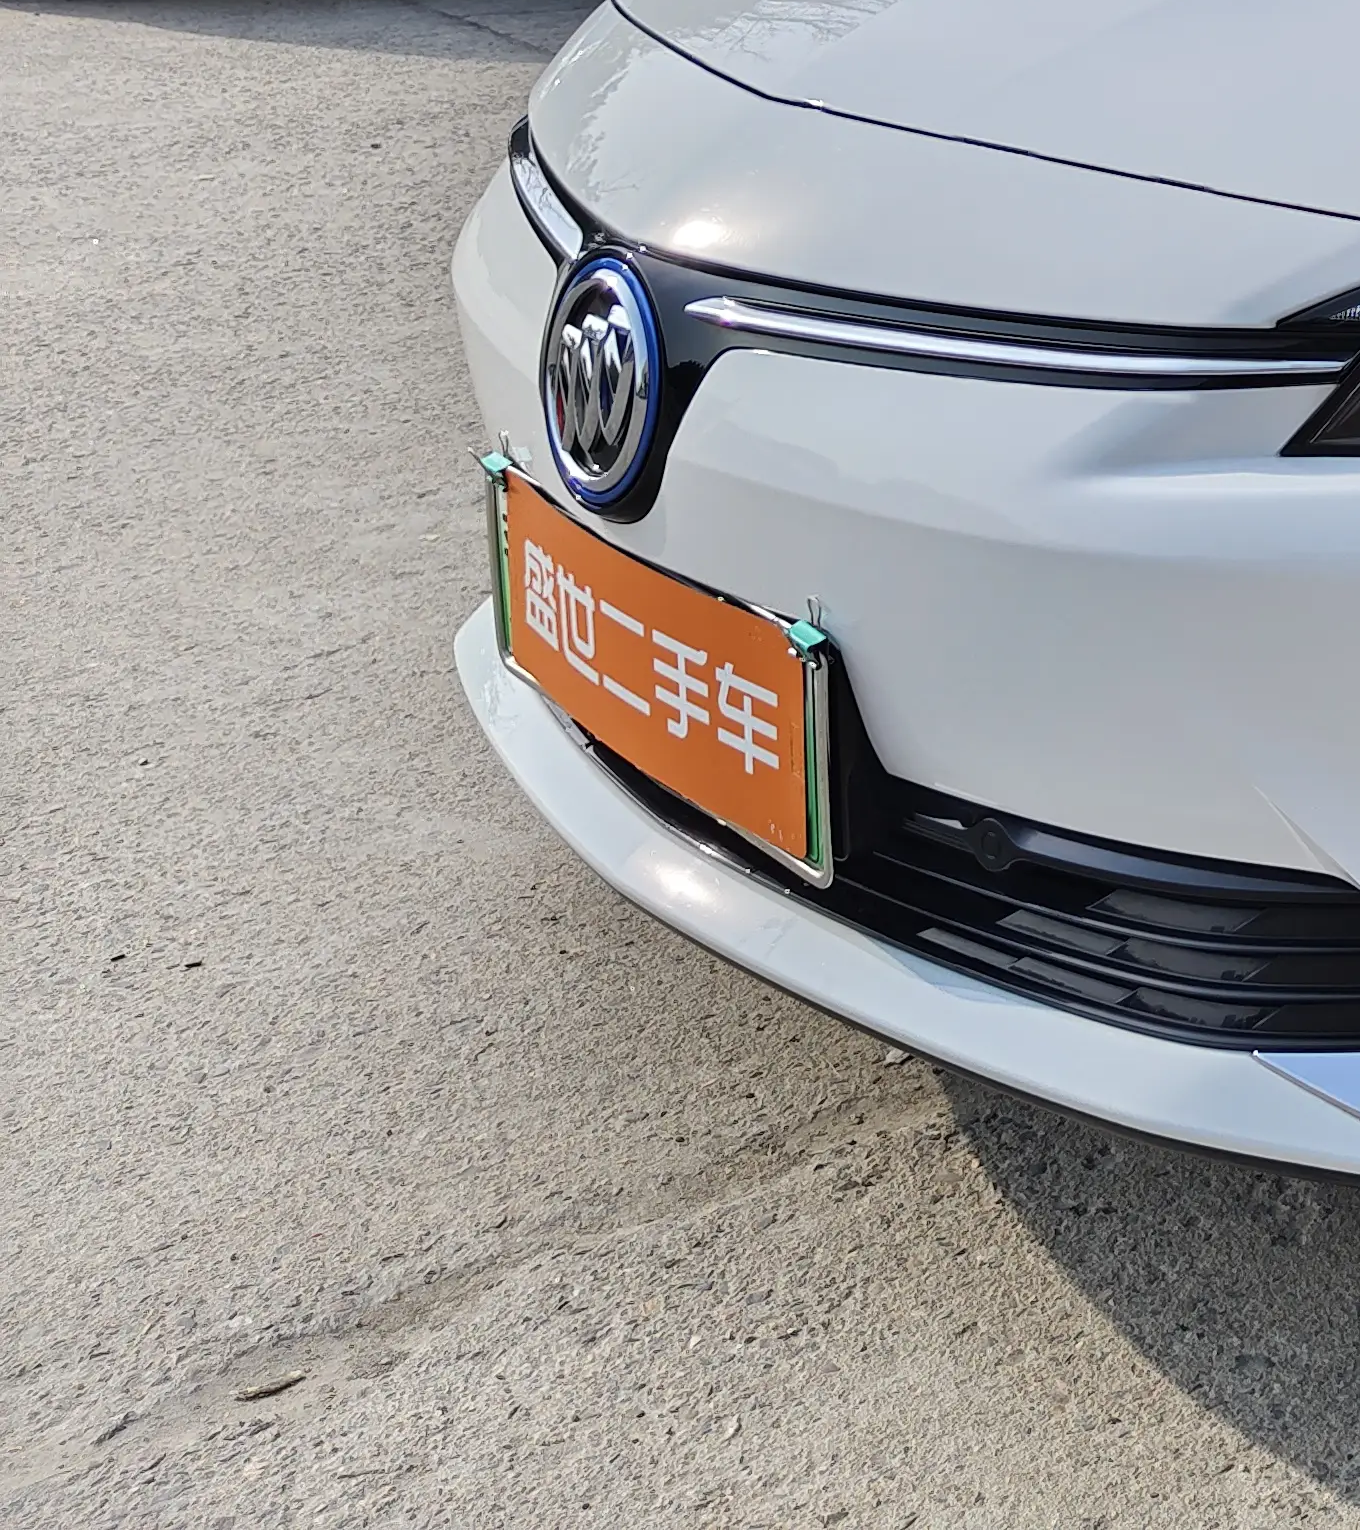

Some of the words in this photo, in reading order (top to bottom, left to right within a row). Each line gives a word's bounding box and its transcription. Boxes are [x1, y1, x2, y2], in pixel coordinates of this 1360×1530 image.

[523, 537, 780, 776] 盛世二手车
